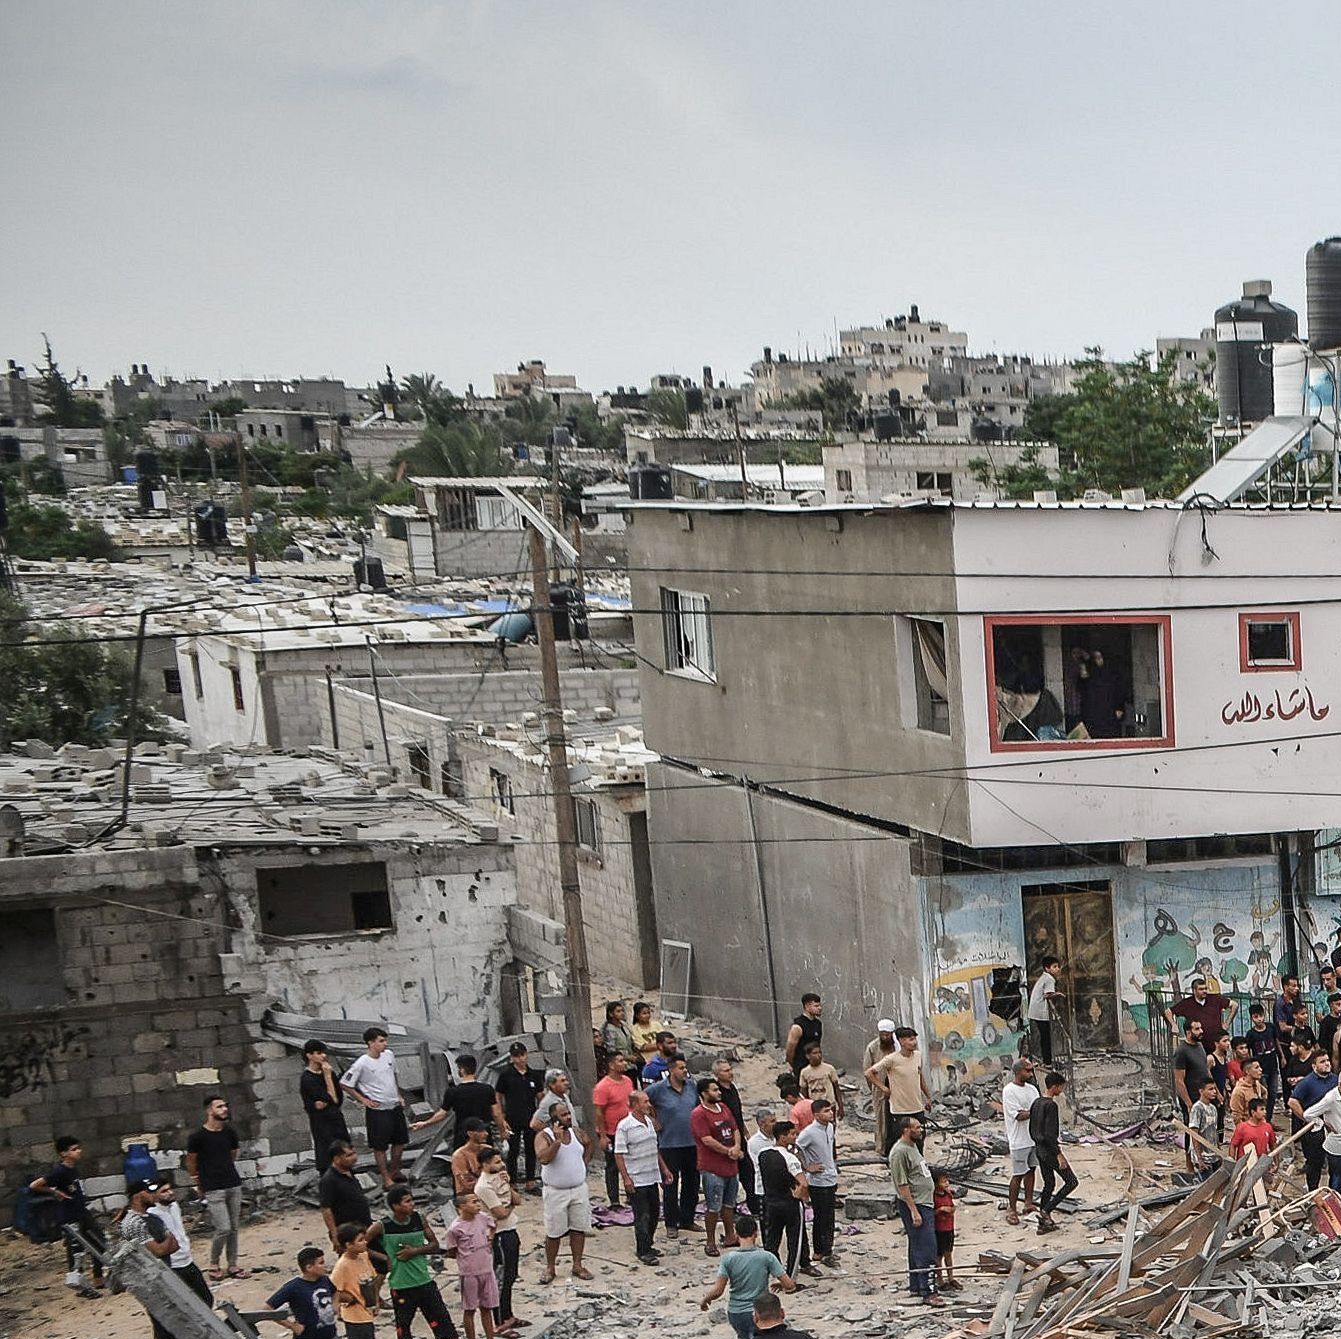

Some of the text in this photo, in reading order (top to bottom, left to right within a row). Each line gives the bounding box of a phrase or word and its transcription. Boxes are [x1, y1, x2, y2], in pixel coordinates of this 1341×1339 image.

[1221, 686, 1330, 725] ما شاء الله
